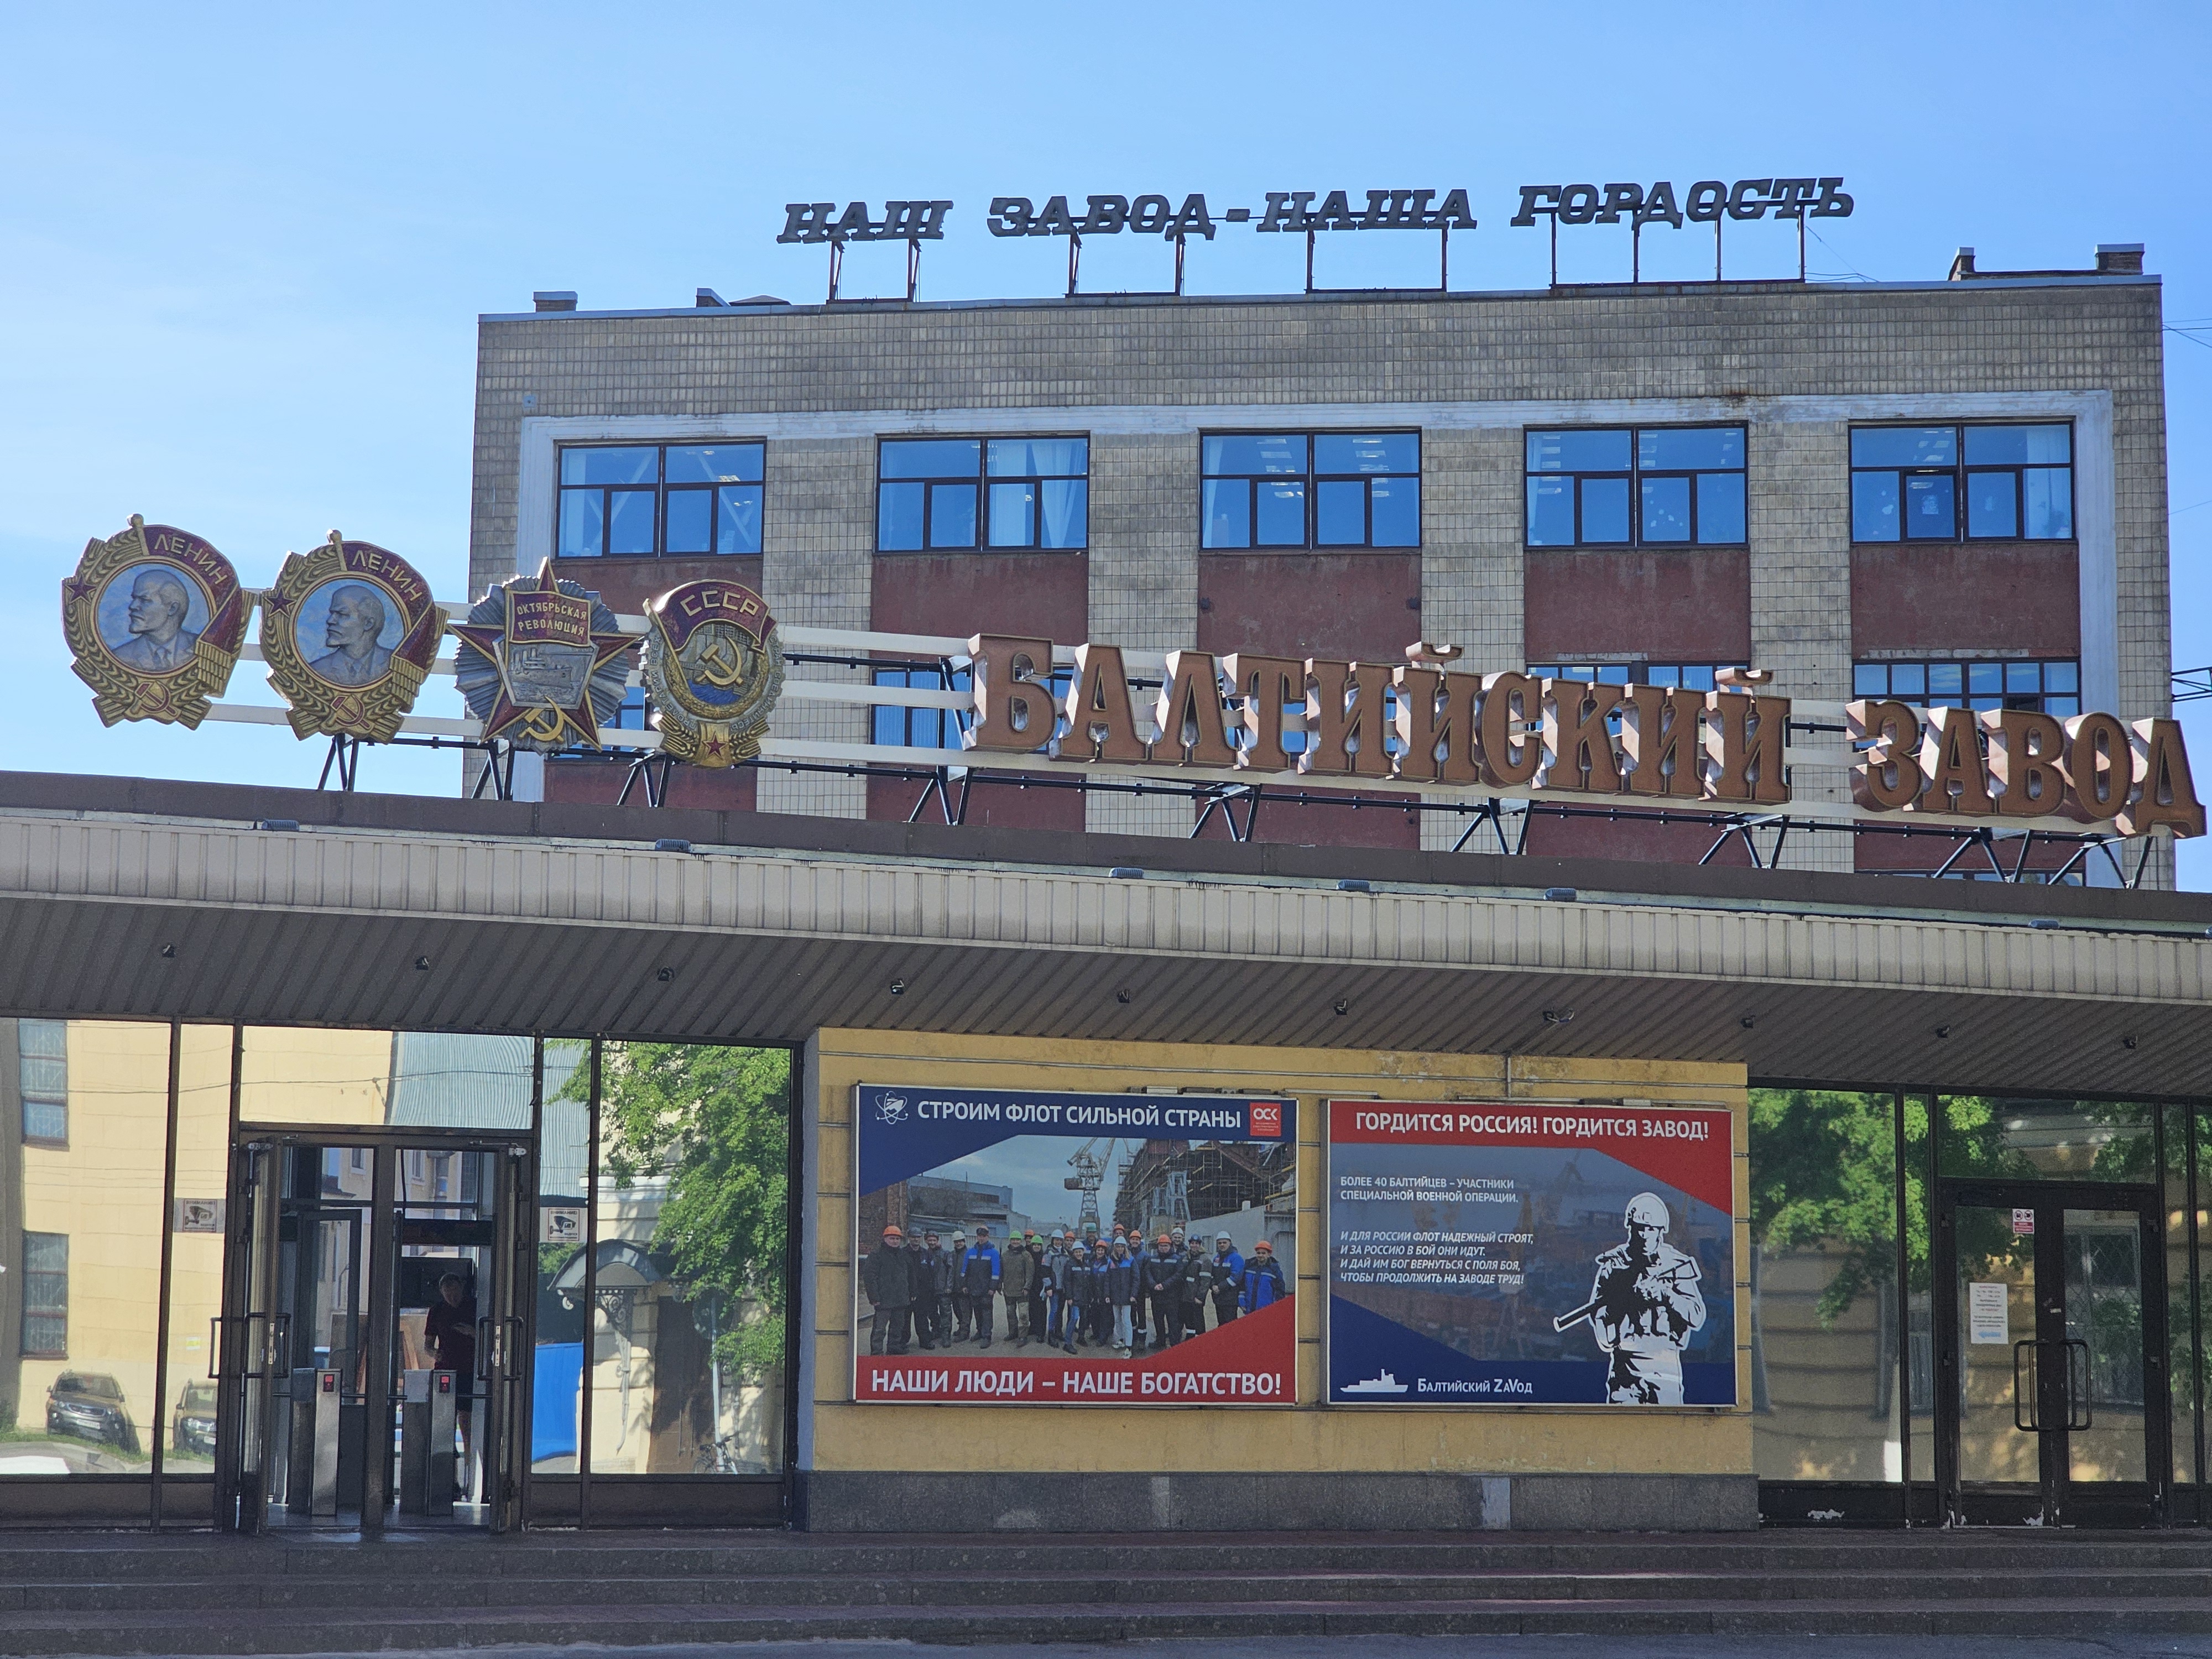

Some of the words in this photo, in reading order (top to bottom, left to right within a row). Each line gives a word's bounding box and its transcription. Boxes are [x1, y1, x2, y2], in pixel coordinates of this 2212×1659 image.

[776, 200, 953, 244] НАШ
[987, 194, 1216, 241] ЗАВОД
[1256, 189, 1477, 232] НАША
[1510, 178, 1854, 229] ГОРДОСТЬ
[155, 534, 228, 586] ЛЕНИН
[352, 550, 422, 602] ЛЕНИН
[517, 602, 586, 619] ОКТЯБРЬСКАЯ
[680, 591, 759, 616] СССР
[518, 619, 585, 637] РЕВОЛЮЦИЯ
[650, 637, 661, 666] ВСЕХ
[963, 633, 1792, 804] БАЛТИЙСКИЙ
[1846, 699, 2207, 839] ЗАВОД
[917, 1100, 1000, 1121] СТРОИМ
[1006, 1103, 1062, 1124] ФЛОТ
[1066, 1103, 1159, 1127] СИЛЬНОЙ
[1165, 1108, 1241, 1128] СТРАНЫ
[1356, 1112, 1453, 1133] ГОРДИТСЯ
[1459, 1115, 1538, 1134] РОССИЯ!
[1543, 1117, 1636, 1138] ГОРДИТСЯ
[1642, 1120, 1709, 1141] ЗАВОД!
[1340, 1176, 1372, 1186] БОЛЕЕ
[1374, 1177, 1387, 1187] 40
[1389, 1176, 1447, 1188] БАЛТИЙЦЕВ
[1457, 1178, 1514, 1189] УЧАСТНИКИ
[1340, 1190, 1414, 1201] СПЕЦИАЛЬНОЙ
[1416, 1190, 1463, 1202] ВОЕННОЙ
[1465, 1192, 1519, 1203] ОПЕРАЦИИ.
[1340, 1232, 1348, 1241] И
[1349, 1231, 1370, 1242] ДЛЯ
[1373, 1232, 1411, 1241] РОССИИ
[1413, 1232, 1440, 1242] ФЛОТ
[1441, 1231, 1496, 1243] НАДЕЖНЫЙ
[1498, 1233, 1534, 1244] СТРОЯТ,
[1340, 1245, 1348, 1254] И
[1350, 1245, 1362, 1255] ЗА
[1364, 1245, 1405, 1255] РОССИЮ
[1407, 1245, 1413, 1255] В
[1415, 1244, 1436, 1255] БОЙ
[1437, 1246, 1458, 1256] ОНИ
[1459, 1246, 1486, 1256] ИДУТ.
[1340, 1259, 1348, 1267] И
[1349, 1258, 1370, 1270] ДАЙ
[1373, 1259, 1389, 1269] ИМ
[1391, 1259, 1410, 1269] БОГ
[1411, 1259, 1463, 1270] ВЕРНУТЬСЯ
[1465, 1260, 1470, 1270] С
[1472, 1260, 1499, 1270] ПОЛЯ
[1500, 1260, 1521, 1272] БОЯ,
[1340, 1272, 1374, 1282] ЧТОБЫ
[1376, 1272, 1442, 1284] ПРОДОЛЖИТЬ
[1444, 1273, 1457, 1283] НА
[1459, 1274, 1496, 1284] ЗАВОДЕ
[1498, 1274, 1525, 1285] ТРУД!
[872, 1369, 949, 1394] НАШИ
[954, 1370, 1034, 1396] ЛЮДИ
[1062, 1371, 1134, 1394] НАШЕ
[1140, 1373, 1282, 1395] БОГАТСТВО!
